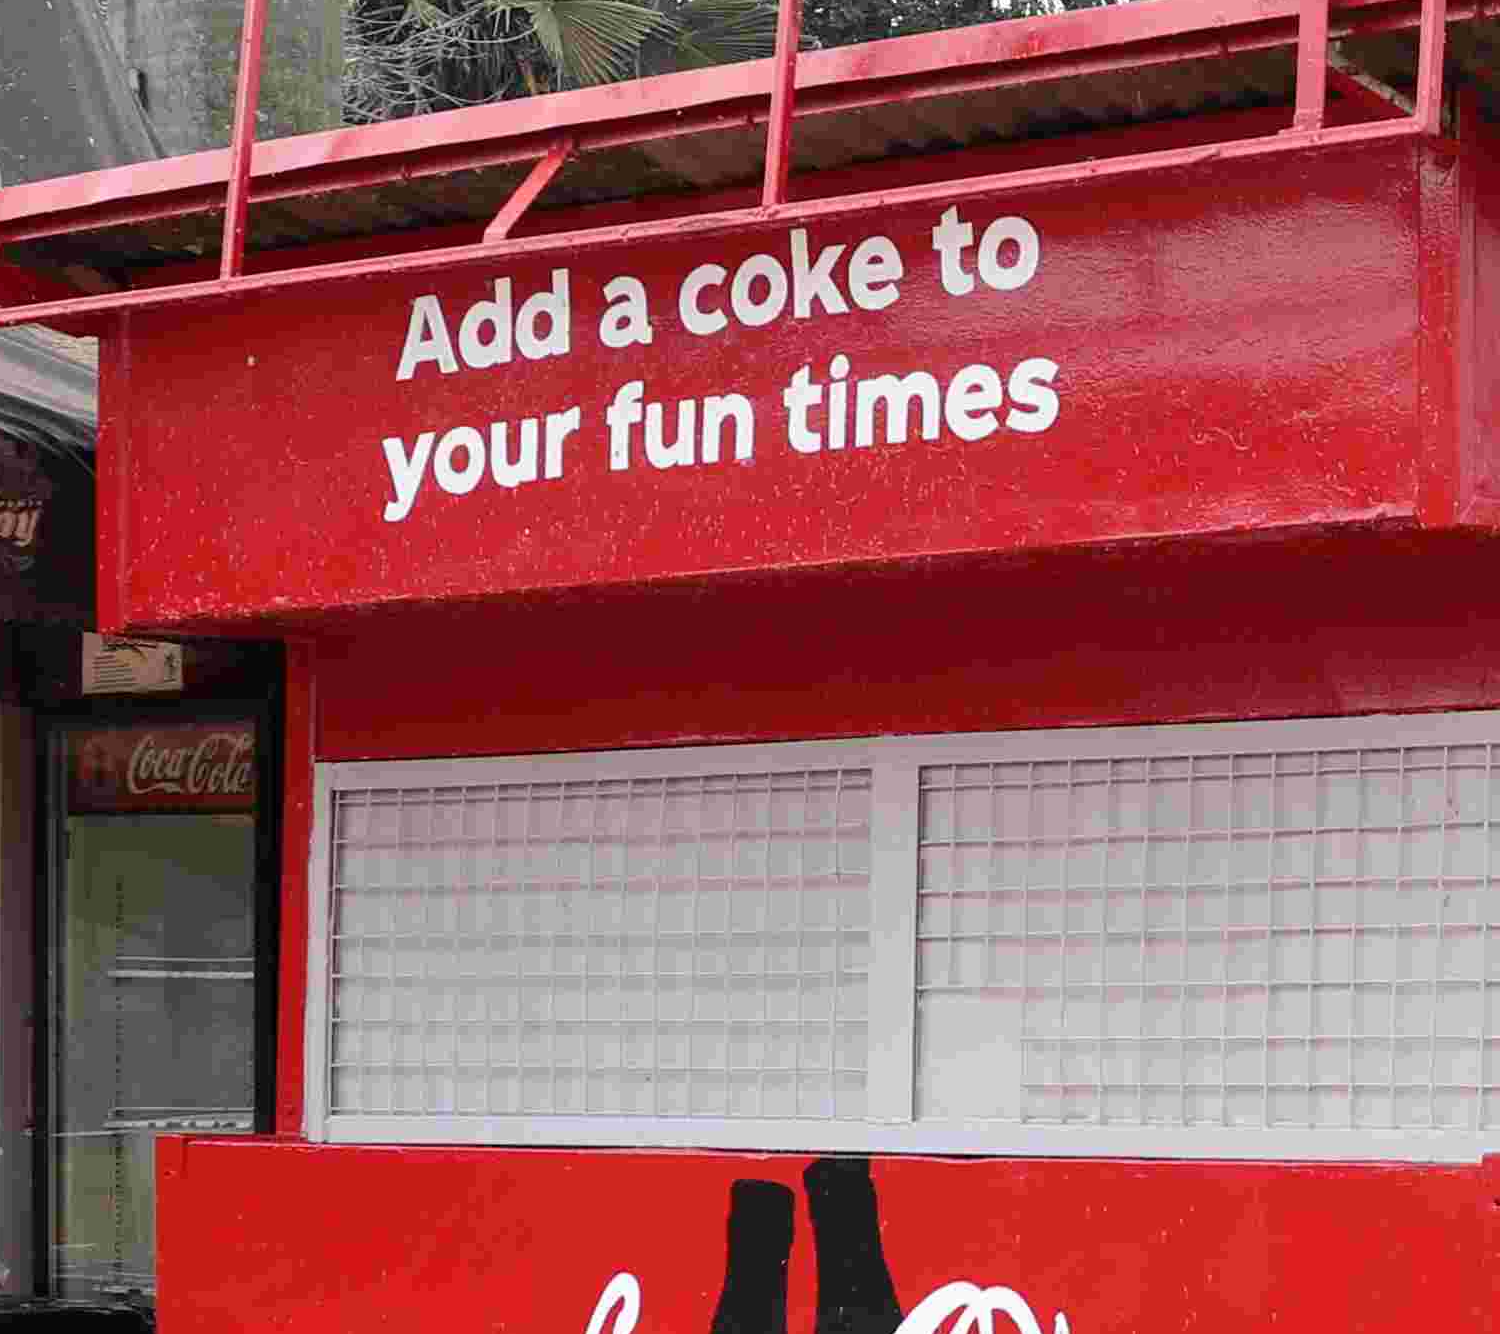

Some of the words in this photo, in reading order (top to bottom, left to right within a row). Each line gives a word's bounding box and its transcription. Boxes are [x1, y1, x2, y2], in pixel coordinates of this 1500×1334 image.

[395, 269, 572, 382] Add
[599, 276, 653, 349] a
[678, 230, 905, 336] coke
[932, 206, 1041, 296] to
[382, 404, 580, 523] your
[606, 380, 756, 473] fun
[784, 354, 1062, 454] times
